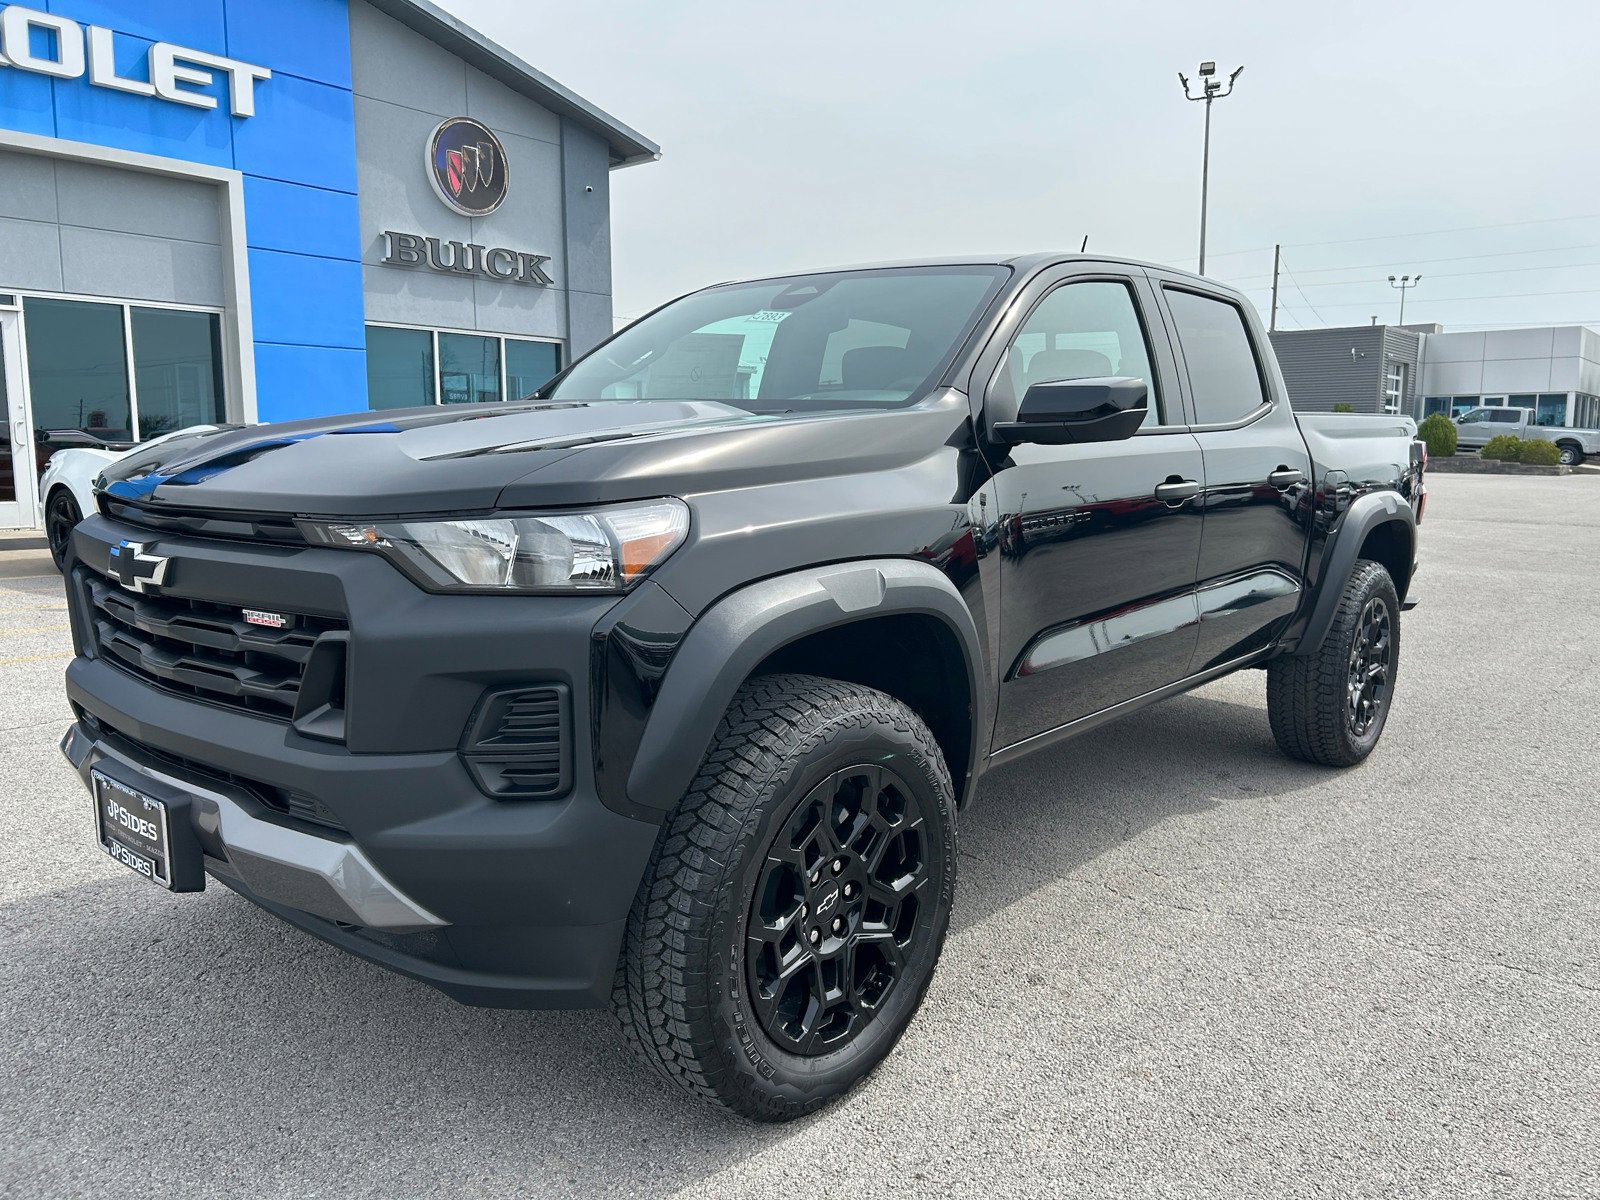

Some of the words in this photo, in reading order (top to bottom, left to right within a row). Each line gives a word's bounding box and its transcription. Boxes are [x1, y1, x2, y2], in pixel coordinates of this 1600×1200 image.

[0, 5, 272, 117] OLET
[379, 230, 554, 285] BUICK
[242, 609, 286, 623] TRAIL
